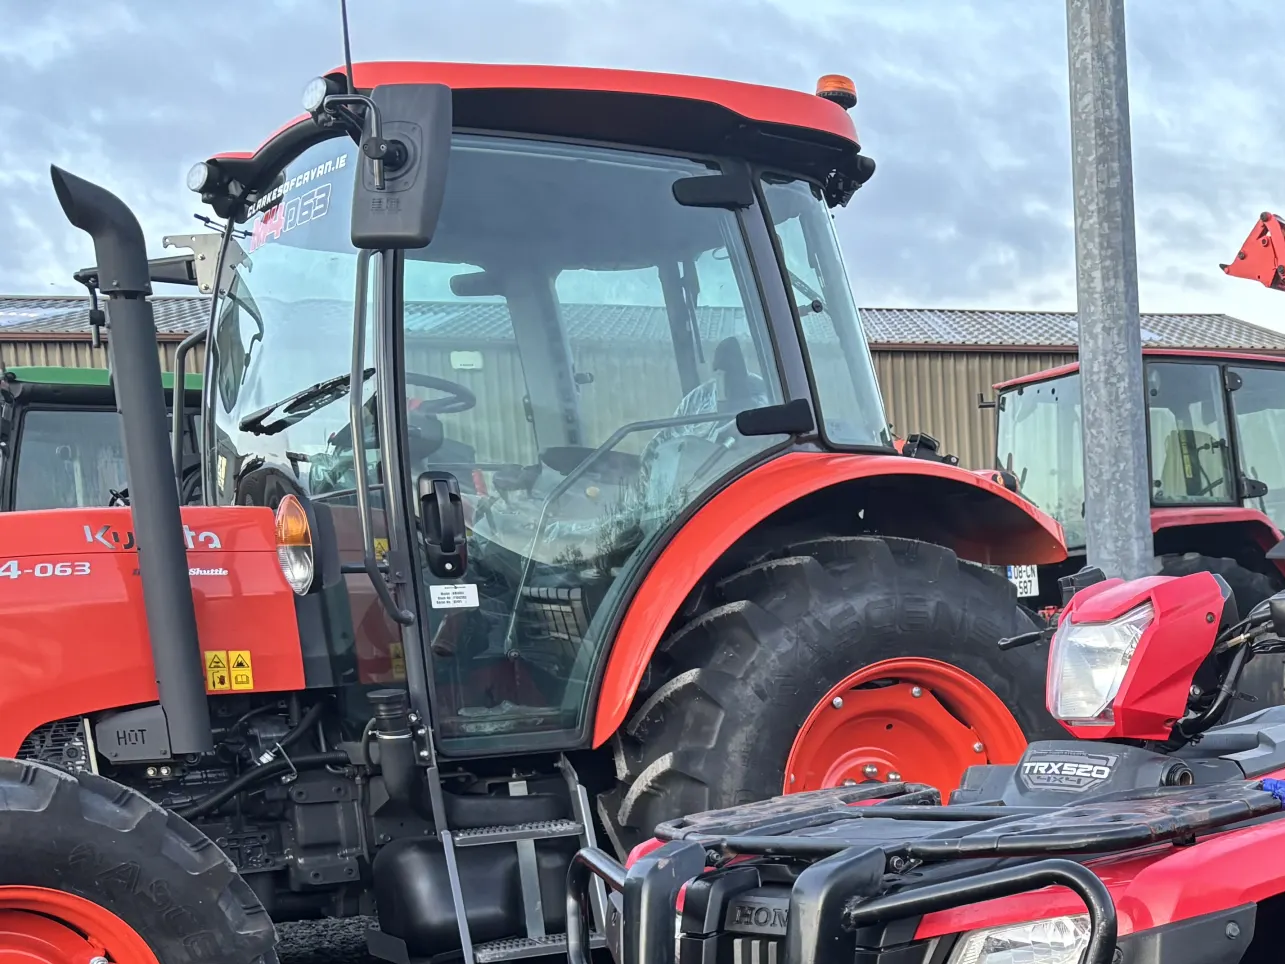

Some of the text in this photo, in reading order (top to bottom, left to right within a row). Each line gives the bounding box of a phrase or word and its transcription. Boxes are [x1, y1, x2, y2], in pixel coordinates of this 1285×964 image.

[247, 154, 347, 218] CLARKESOFCAVAN.IE
[83, 524, 222, 550] Kuta
[188, 567, 229, 576] Shuttle
[116, 729, 147, 746] HOT
[1023, 762, 1110, 779] TRX520
